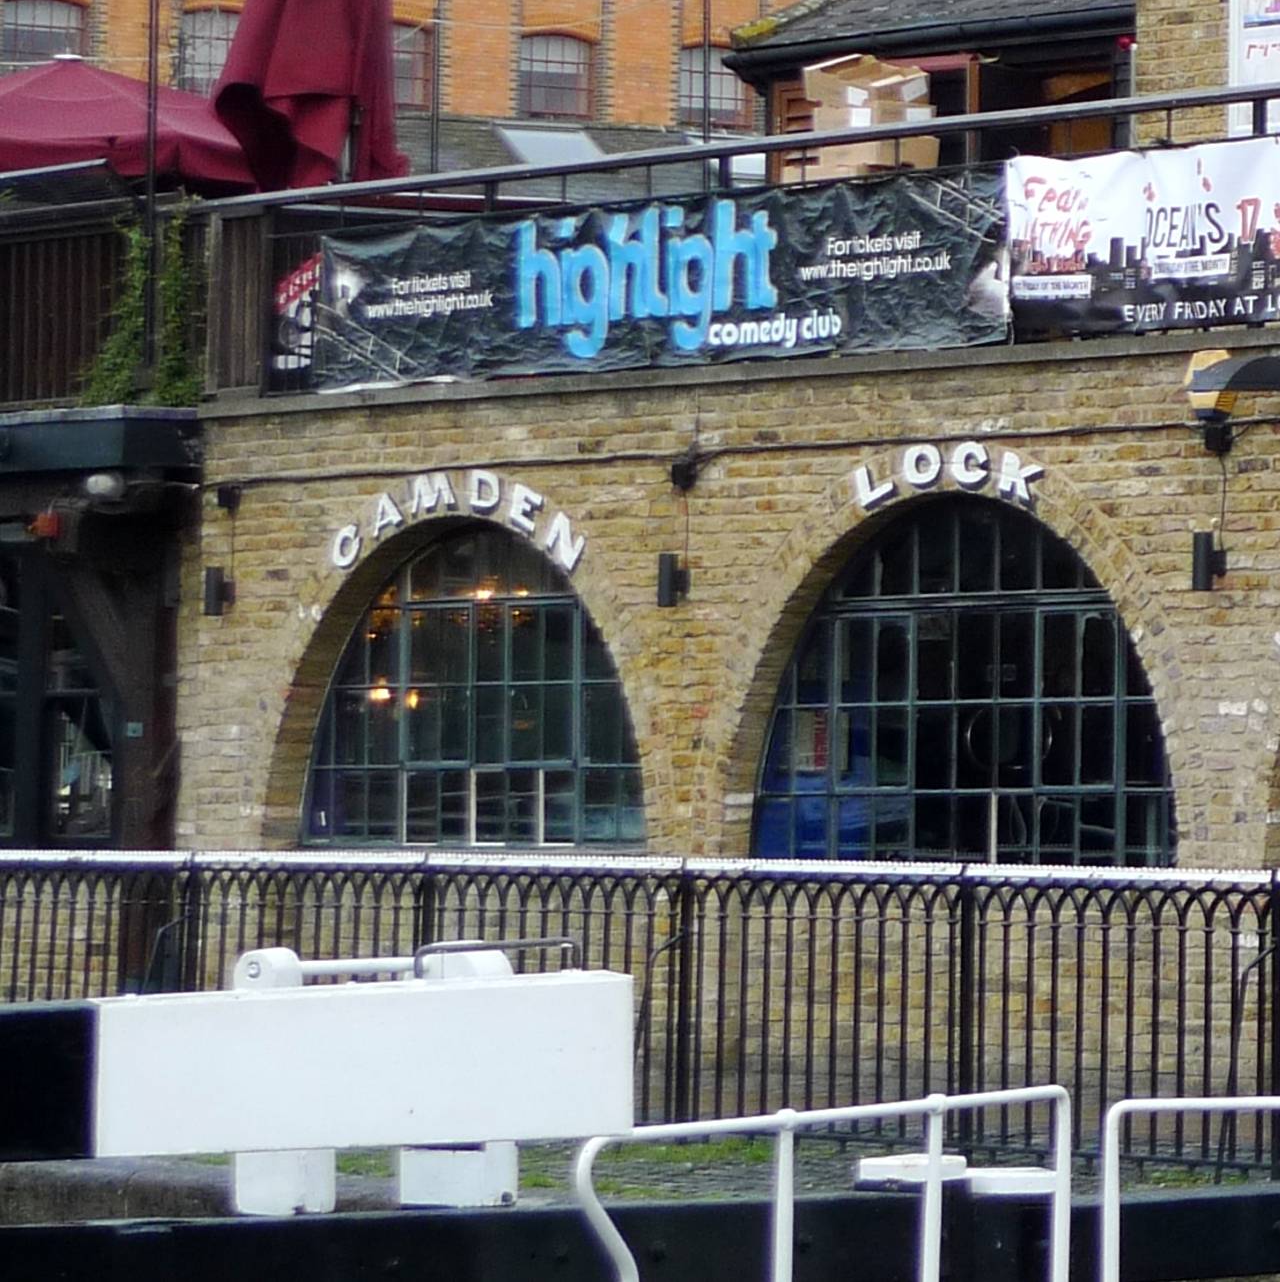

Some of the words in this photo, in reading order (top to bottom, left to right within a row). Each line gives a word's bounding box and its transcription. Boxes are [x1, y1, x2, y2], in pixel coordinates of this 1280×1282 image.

[1236, 199, 1259, 241] 17
[827, 236, 851, 256] For
[895, 231, 921, 250] visit
[516, 199, 778, 358] highlight
[707, 316, 798, 349] comedy
[803, 308, 842, 340] club
[1124, 303, 1166, 323] EVERY
[1174, 298, 1228, 320] FRIDAY
[1234, 295, 1258, 315] AT
[853, 440, 1046, 510] LOCK
[331, 466, 588, 573] CAMDEN
